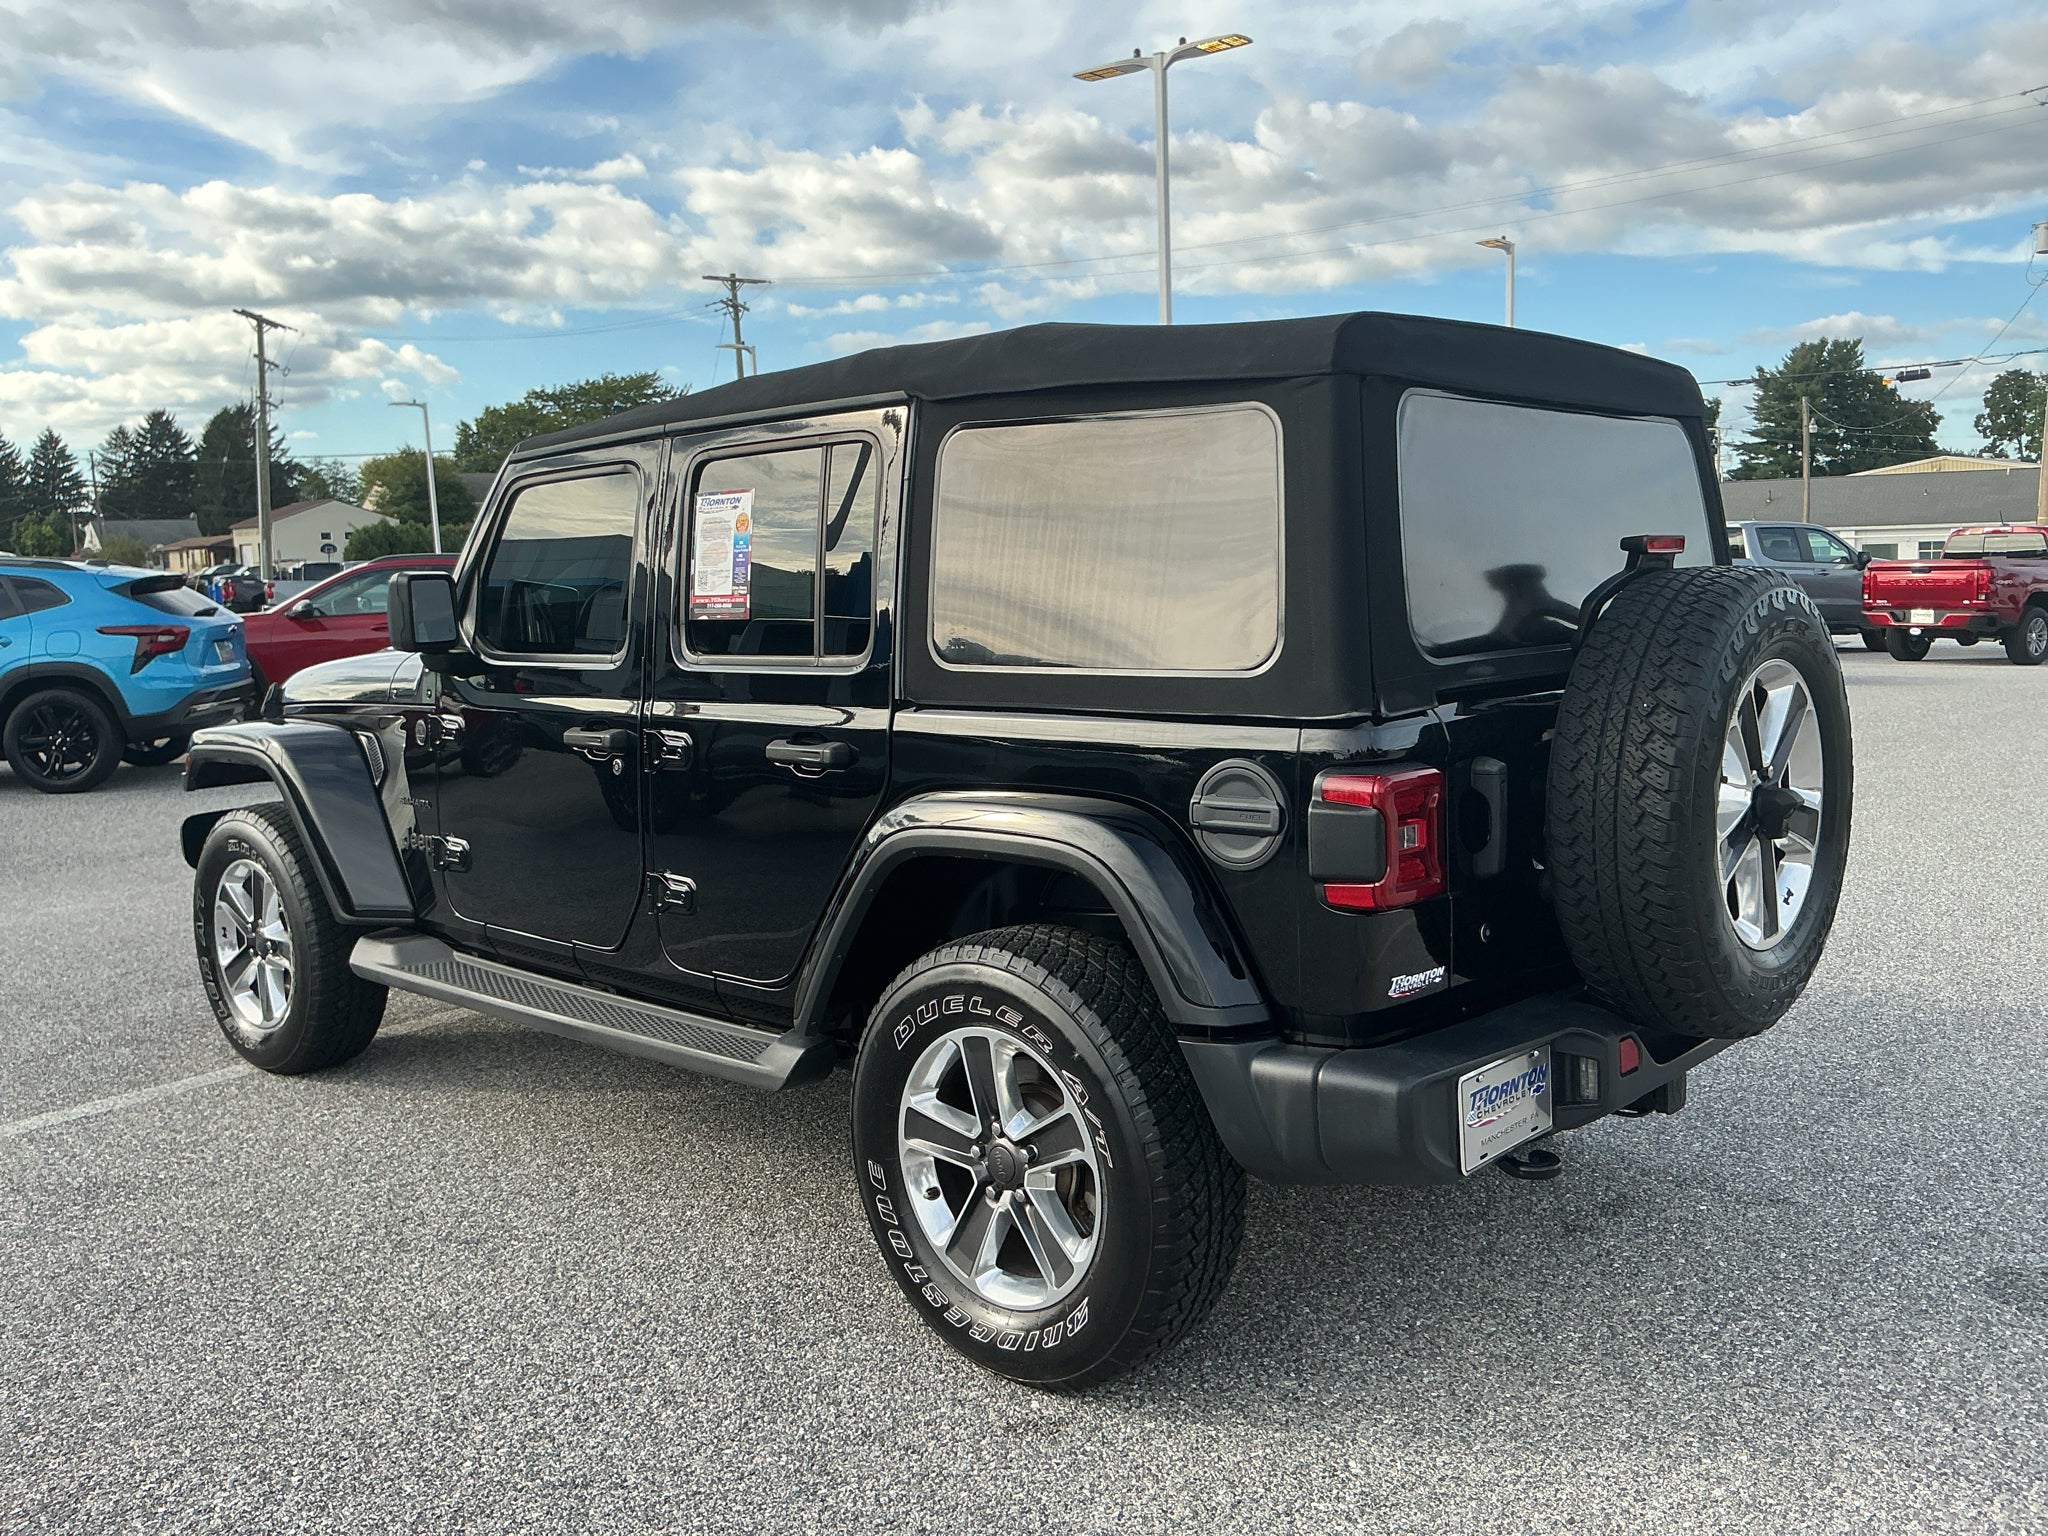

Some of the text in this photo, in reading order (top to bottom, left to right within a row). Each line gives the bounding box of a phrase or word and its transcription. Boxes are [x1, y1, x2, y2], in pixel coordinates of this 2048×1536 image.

[700, 497, 742, 507] THORNTON
[1239, 813, 1264, 821] FUEL
[1391, 966, 1446, 990] THORNTON
[893, 994, 1114, 1169] DUELER A/T
[1469, 1063, 1549, 1111] THORNTON
[1477, 1087, 1533, 1119] CHEVROLET
[868, 1159, 1090, 1352] BRIDGESTONE
